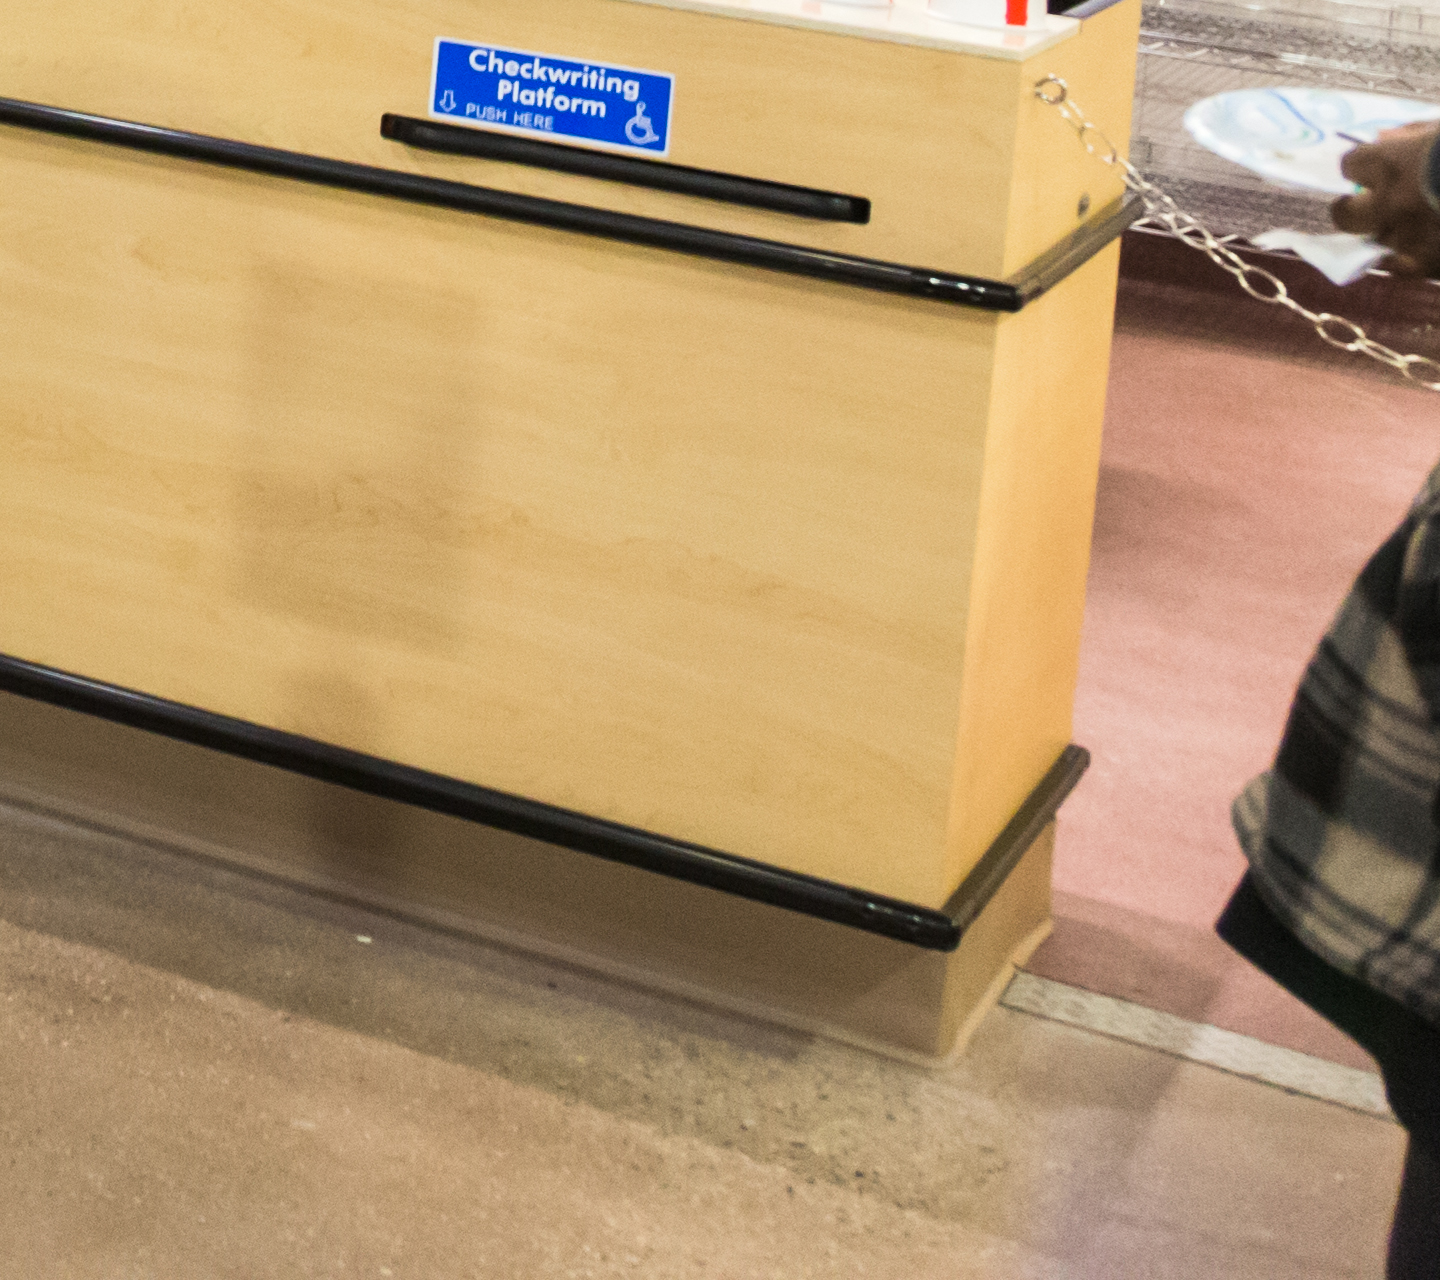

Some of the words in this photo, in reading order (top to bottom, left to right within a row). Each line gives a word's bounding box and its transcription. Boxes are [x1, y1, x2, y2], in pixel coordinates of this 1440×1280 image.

[469, 49, 640, 102] Checkwriting
[465, 102, 507, 123] PUSH
[513, 110, 554, 131] HERE
[497, 79, 607, 118] Platform
